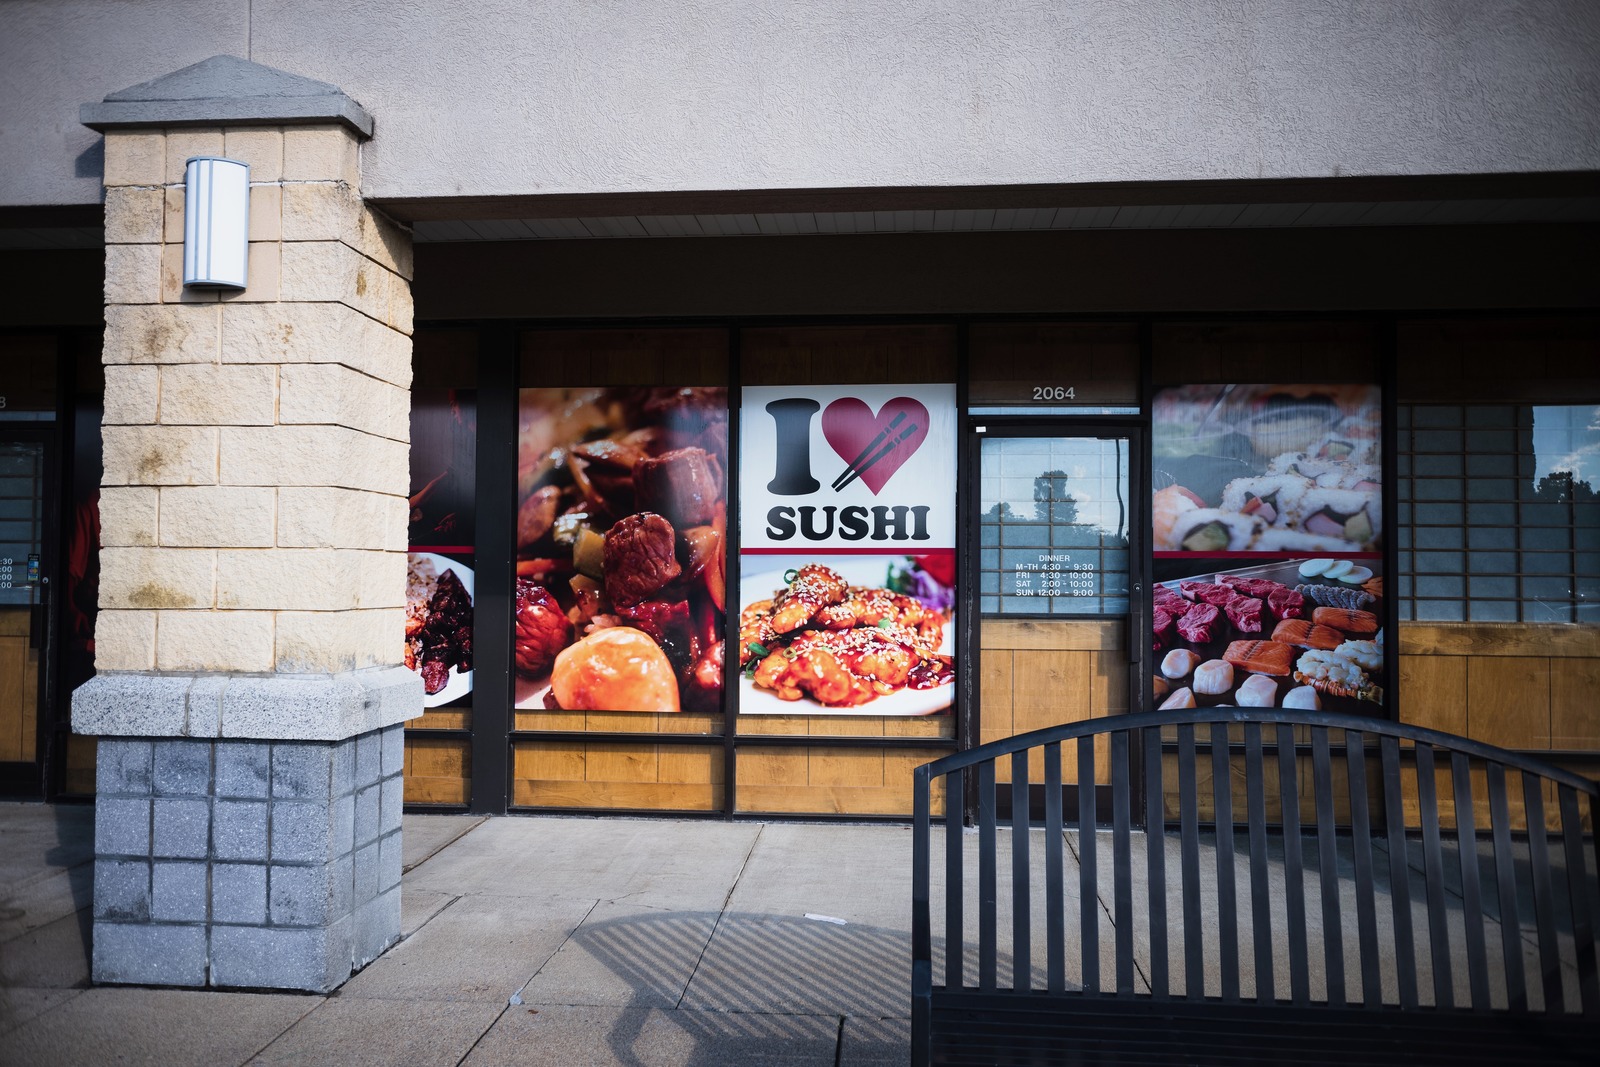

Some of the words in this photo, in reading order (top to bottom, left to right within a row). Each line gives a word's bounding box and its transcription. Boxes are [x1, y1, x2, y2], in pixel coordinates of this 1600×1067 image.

[1033, 386, 1076, 400] 2064
[765, 397, 821, 496] I
[766, 505, 931, 541] SUSHI
[1039, 554, 1071, 562] DINNER
[1015, 563, 1038, 571] M-TH
[1041, 563, 1061, 571] 4:30
[1073, 563, 1094, 571] 9:30
[1015, 580, 1031, 588] SAT
[1041, 580, 1061, 588] 2:00
[1069, 580, 1094, 588] 10:00
[1015, 589, 1034, 597] SUN
[1038, 589, 1061, 597] 12:00
[1073, 589, 1094, 597] 9:00
